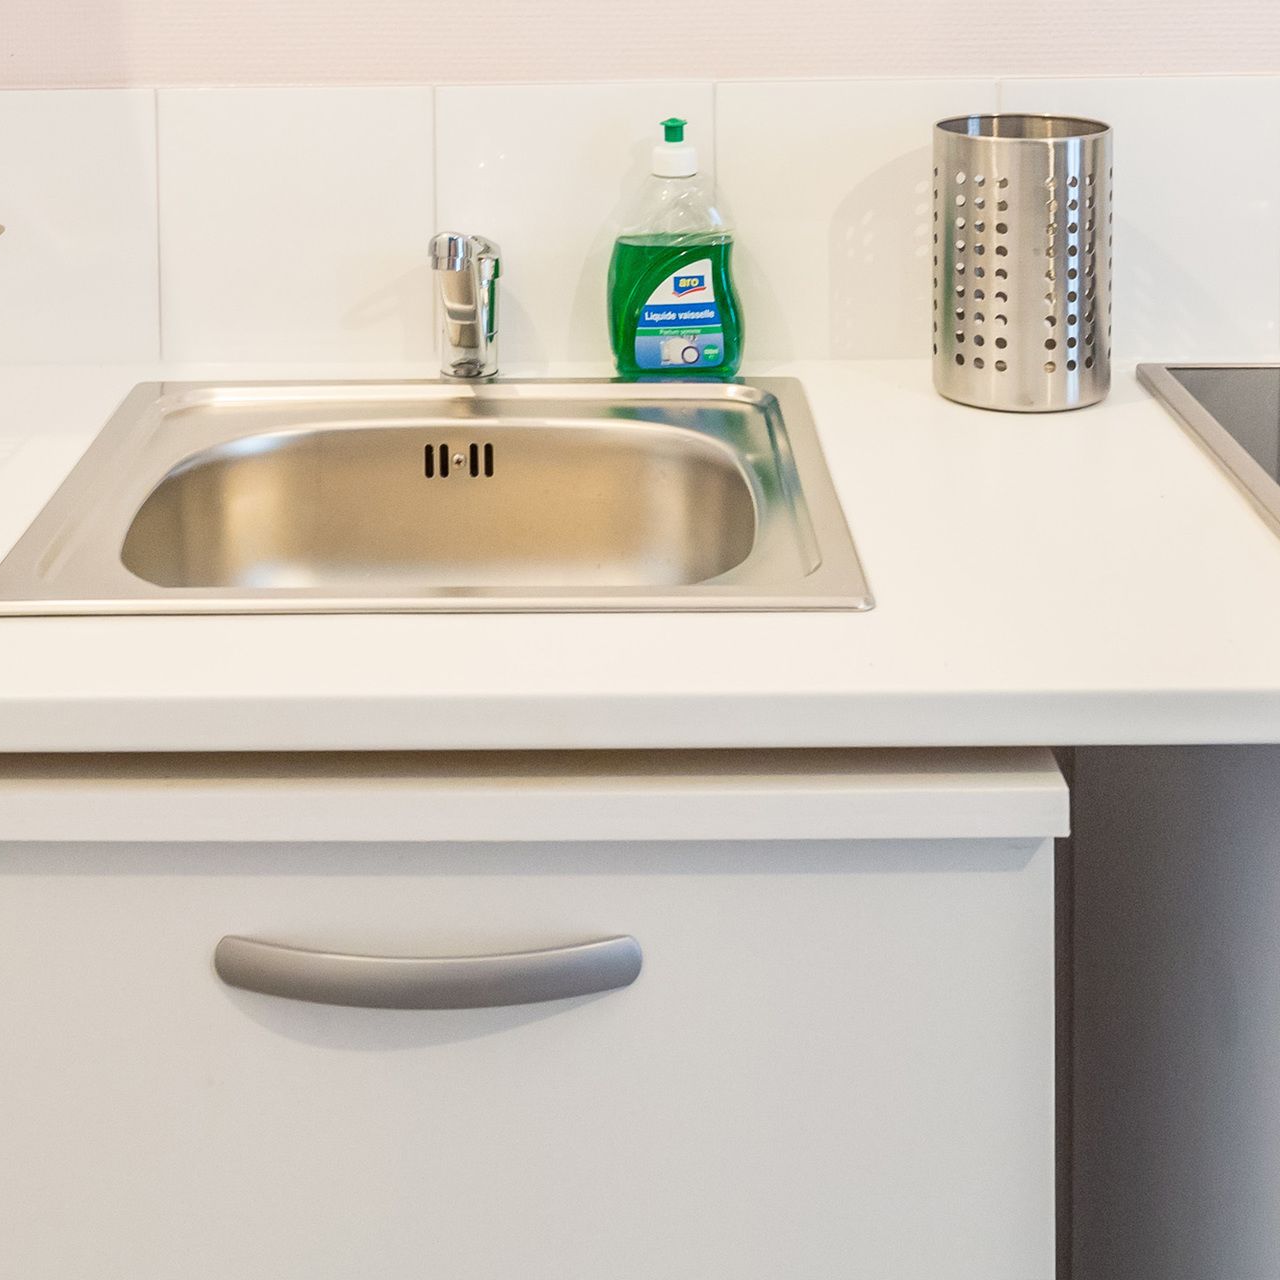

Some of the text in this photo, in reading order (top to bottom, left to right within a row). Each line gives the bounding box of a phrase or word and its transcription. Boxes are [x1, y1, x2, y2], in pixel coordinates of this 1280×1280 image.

[678, 277, 700, 288] aro
[644, 308, 715, 322] Liquide vaisselle
